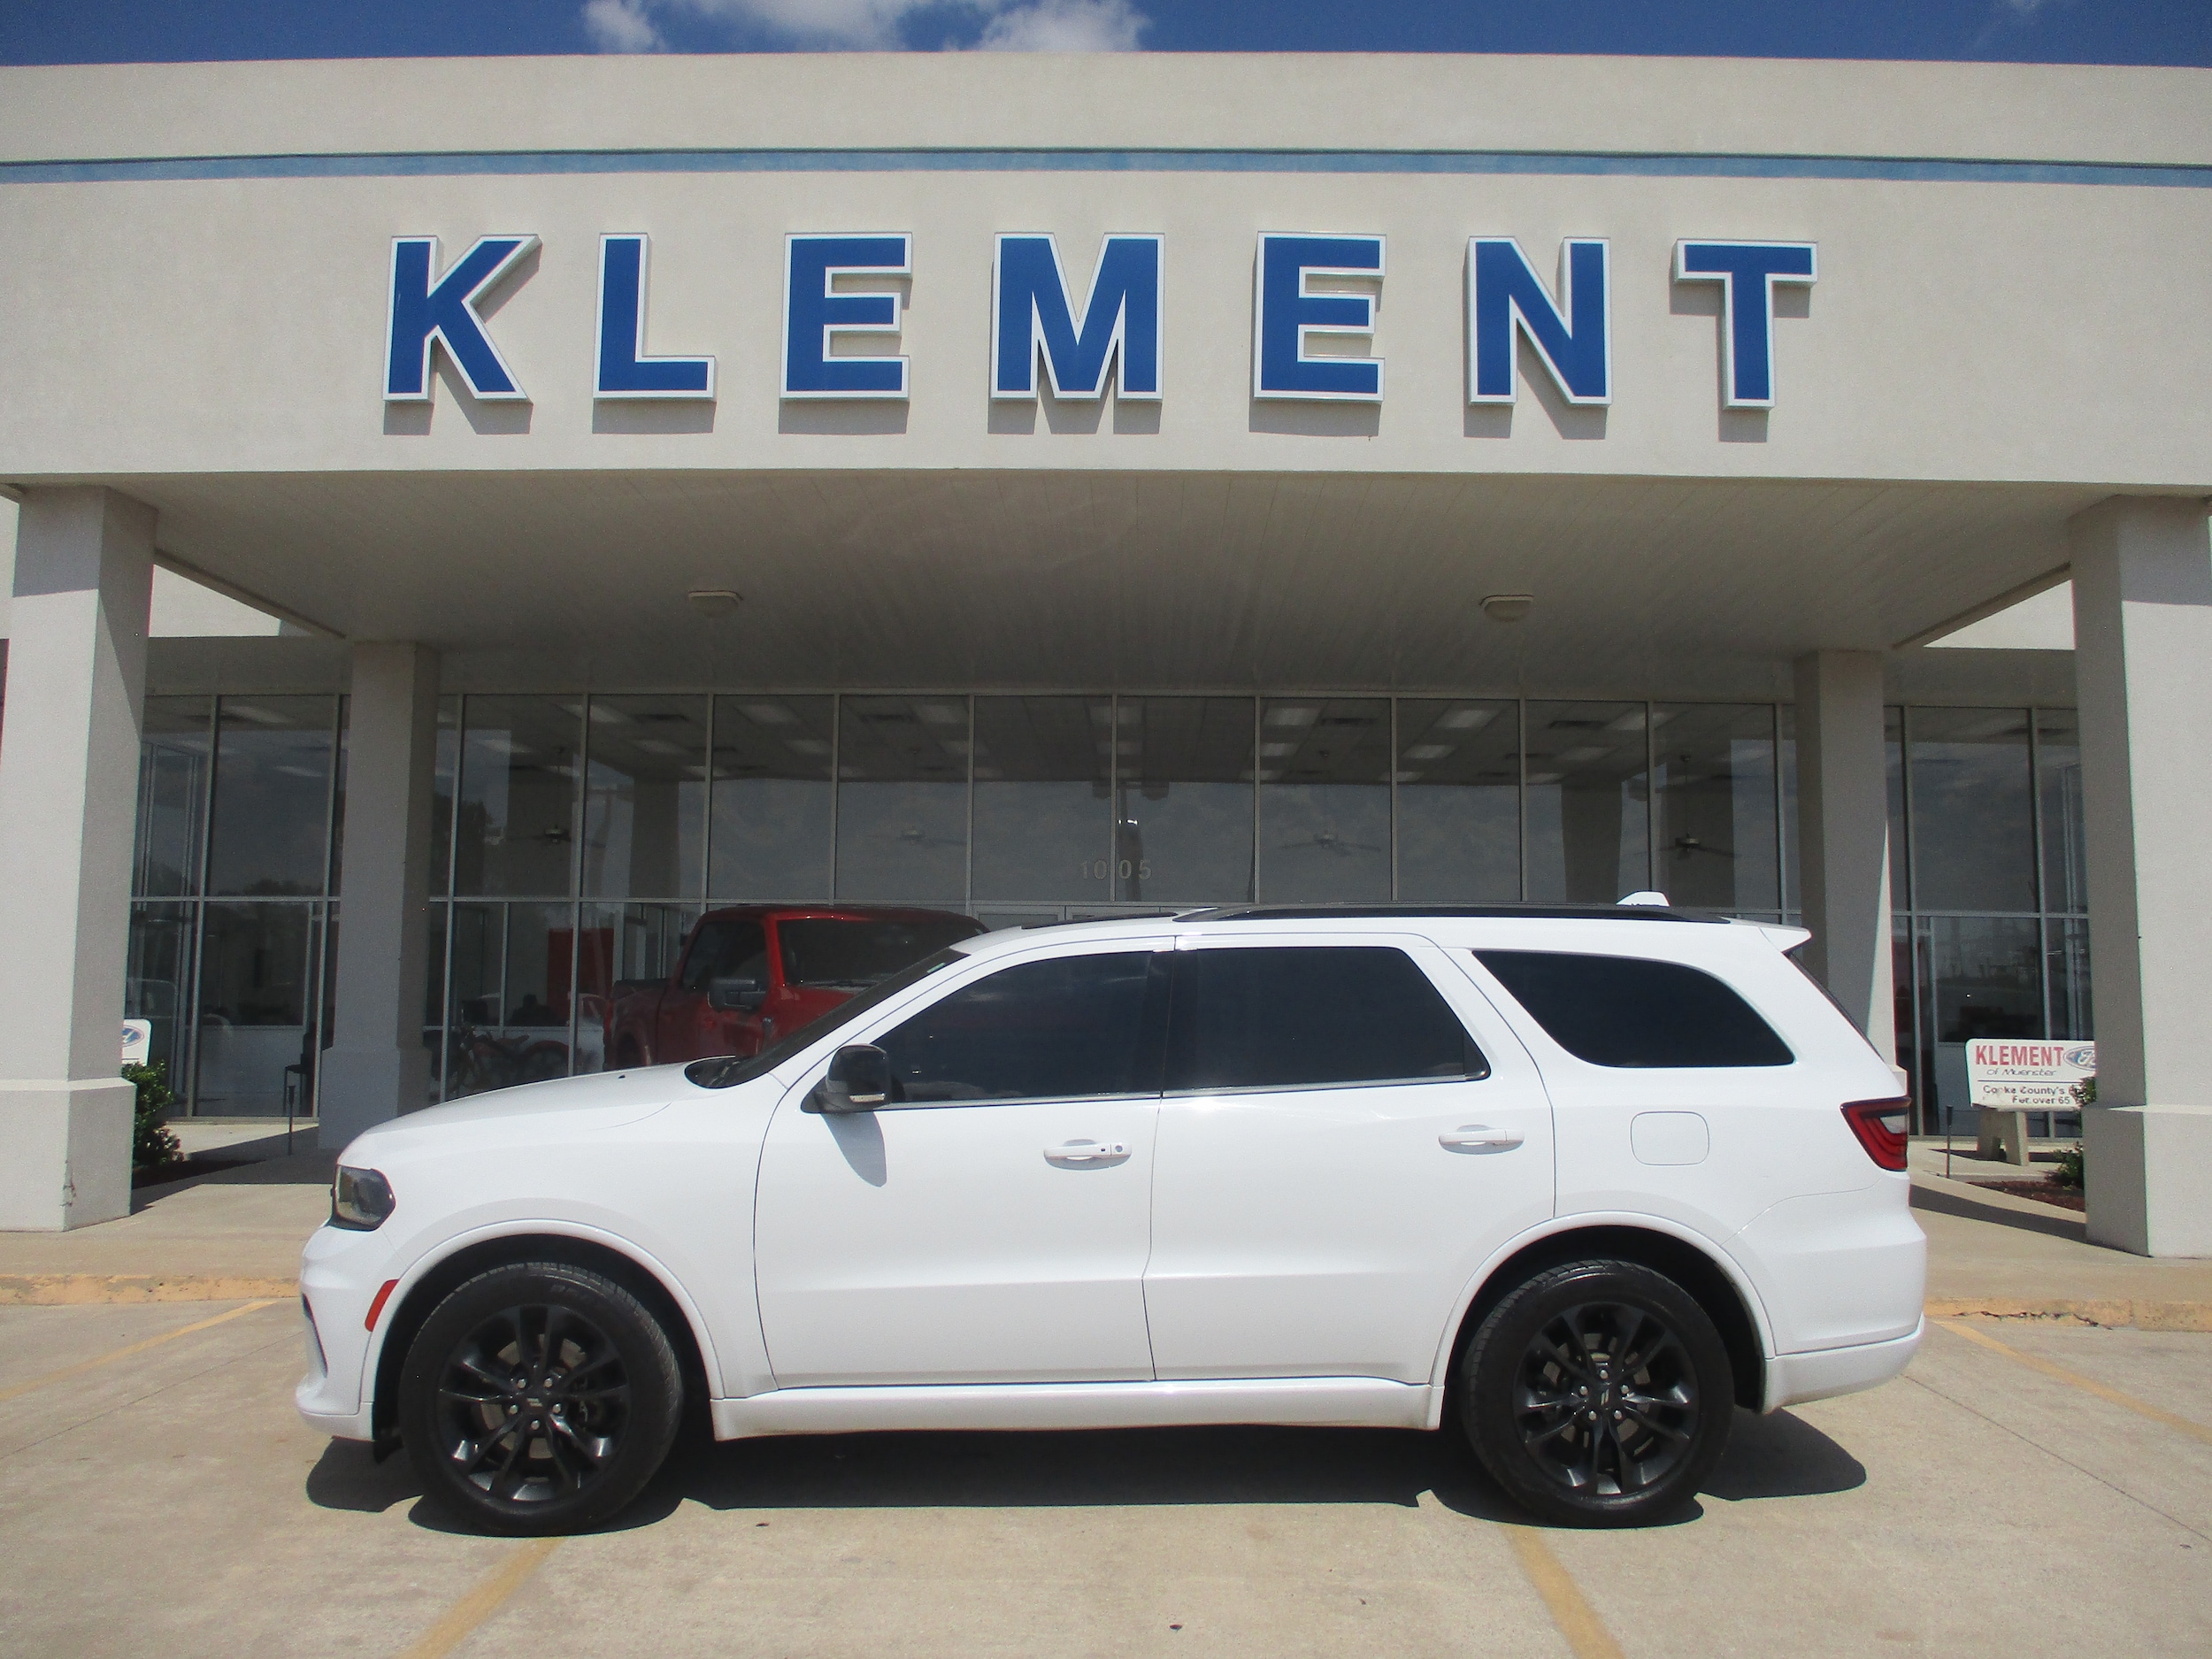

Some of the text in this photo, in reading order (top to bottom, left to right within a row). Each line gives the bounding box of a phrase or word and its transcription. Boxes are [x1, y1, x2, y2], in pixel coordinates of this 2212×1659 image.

[382, 231, 1818, 410] KLEMENT
[1080, 859, 1152, 879] 1005
[1976, 1046, 2064, 1066] KLEMENT
[1983, 1085, 2016, 1094] Coke
[2020, 1087, 2065, 1096] County's
